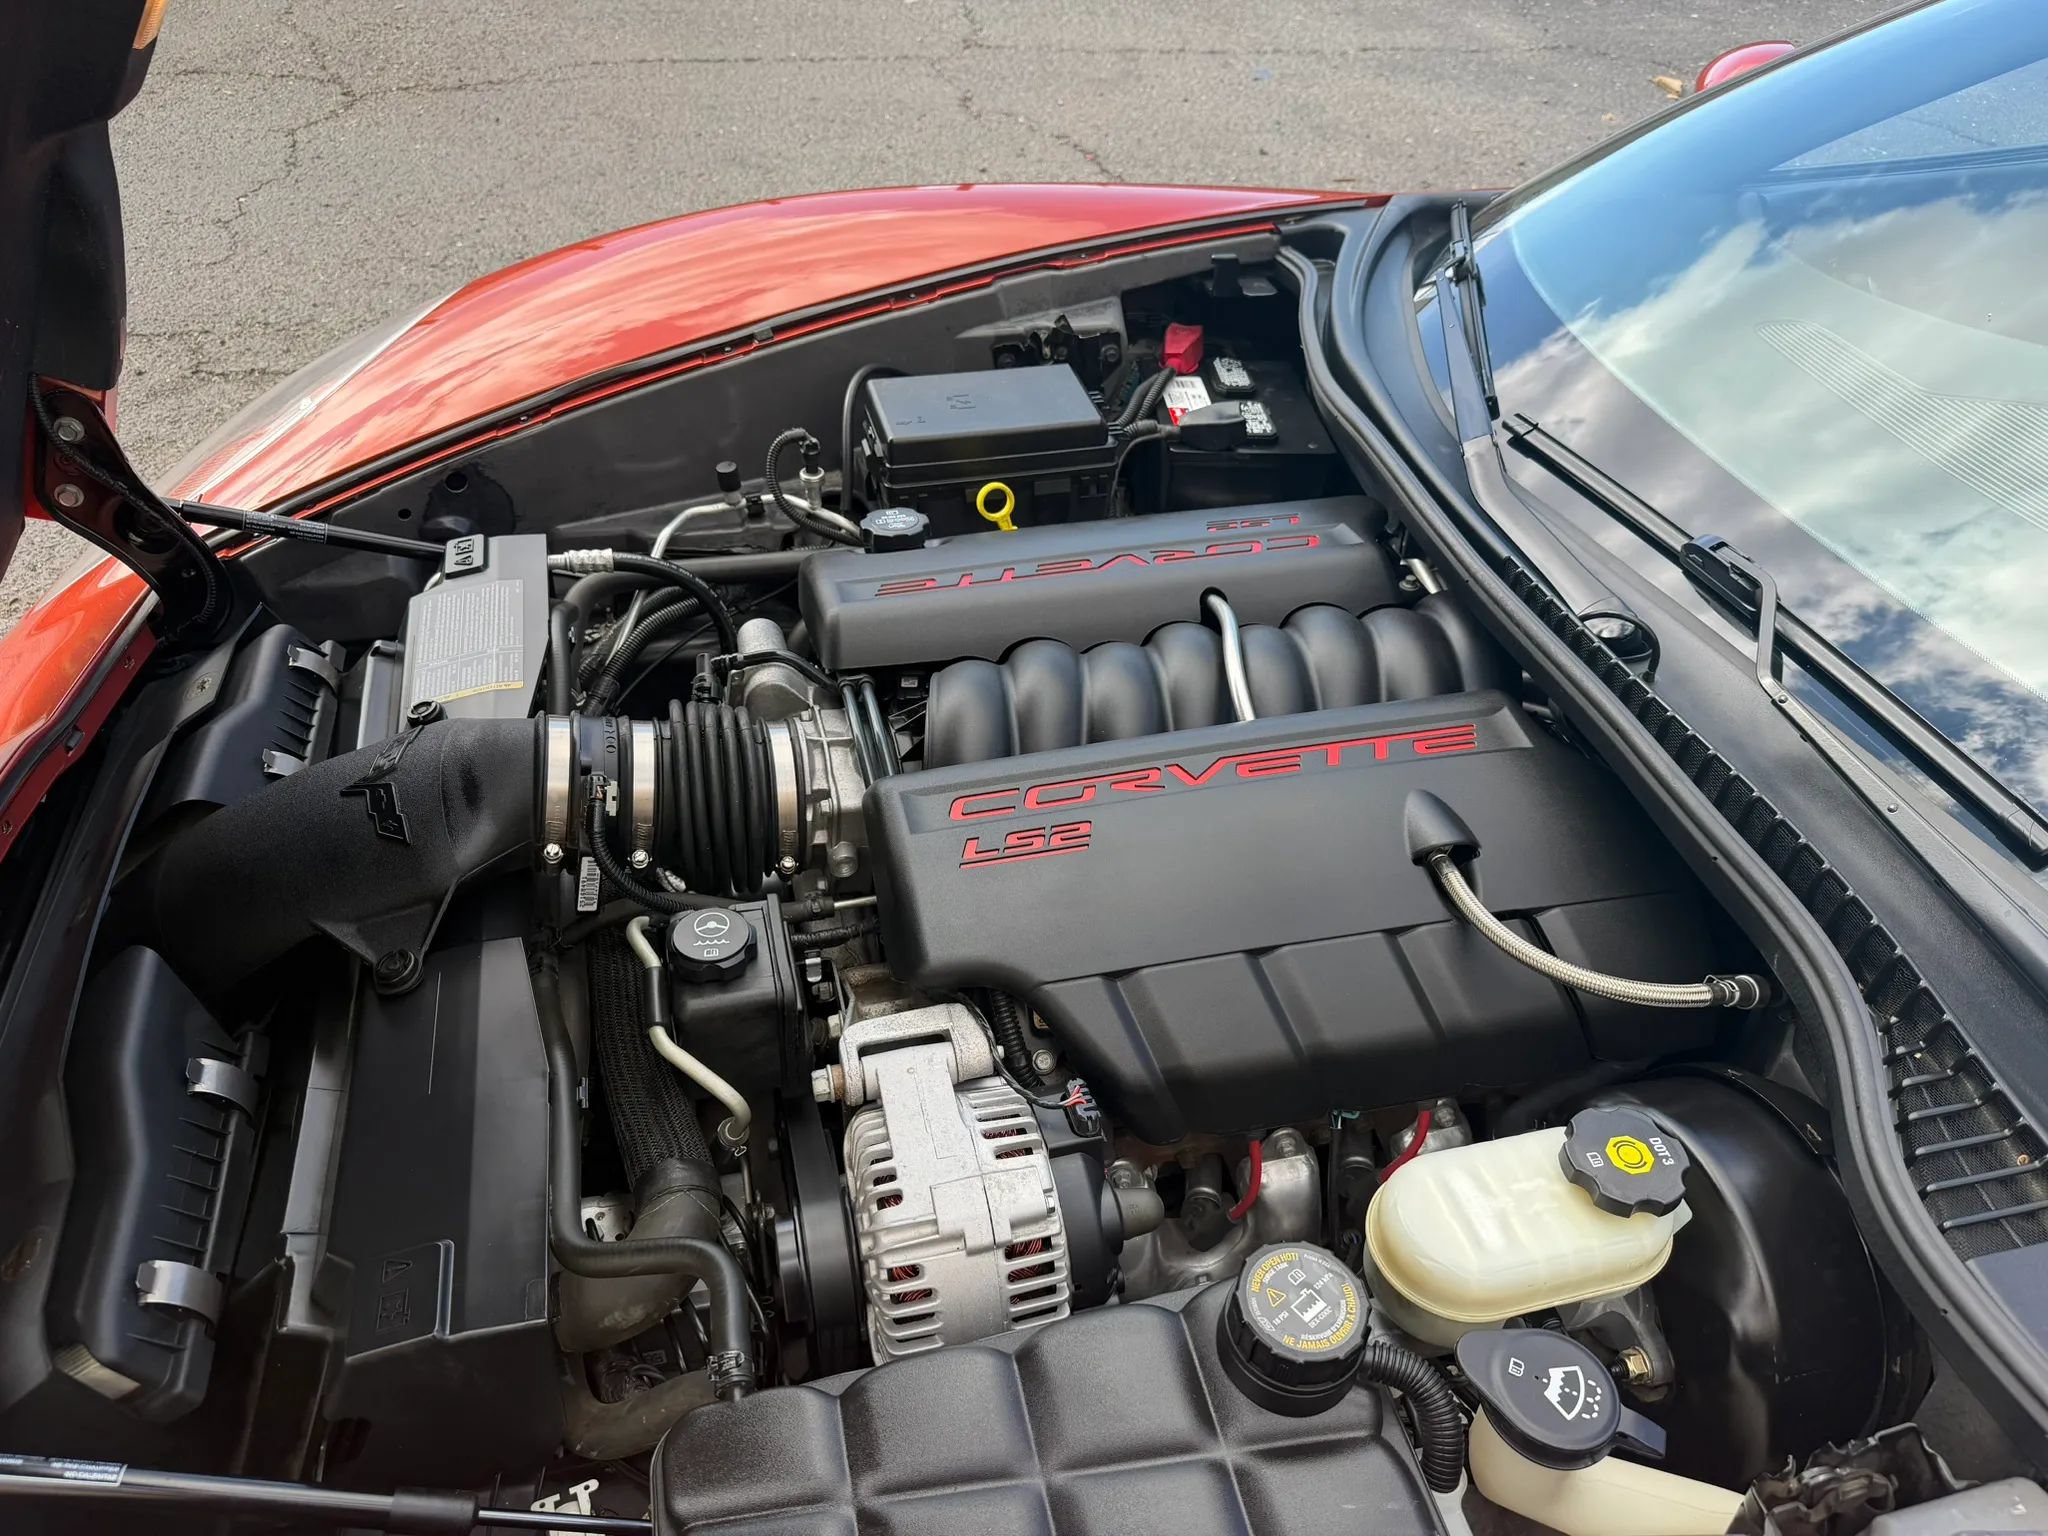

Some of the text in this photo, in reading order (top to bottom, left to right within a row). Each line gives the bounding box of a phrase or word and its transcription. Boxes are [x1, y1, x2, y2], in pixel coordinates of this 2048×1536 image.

[875, 535, 1320, 597] CORVETTE
[948, 723, 1478, 821] CORVETTE
[960, 820, 1092, 863] LS2
[1649, 1137, 1675, 1166] DOT 3
[1251, 1269, 1266, 1292] NEVER
[1261, 1255, 1281, 1272] OPEN
[1280, 1252, 1299, 1263] HOT!
[1313, 1279, 1325, 1289] 124
[1341, 1281, 1357, 1313] CHAUD!
[1272, 1310, 1289, 1326] 18 PSI
[1329, 1319, 1354, 1344] OUVRIR
[1282, 1335, 1297, 1346] NE
[1297, 1338, 1330, 1349] JAMAIS
